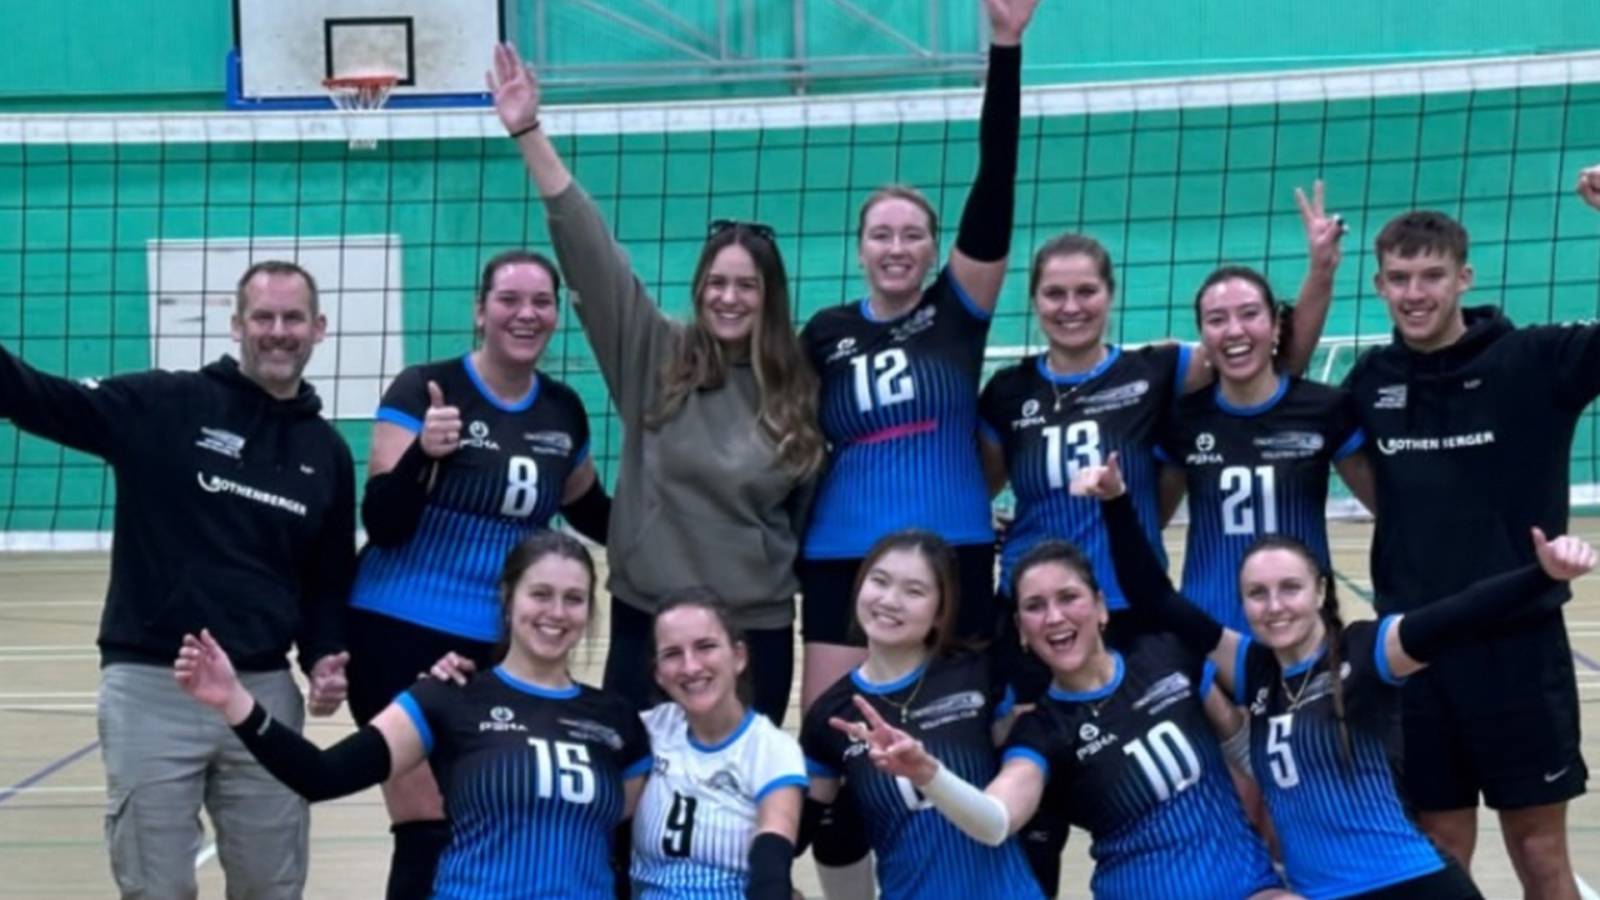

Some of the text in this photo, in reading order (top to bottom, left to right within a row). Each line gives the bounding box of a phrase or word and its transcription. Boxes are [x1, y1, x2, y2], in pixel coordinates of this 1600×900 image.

[849, 348, 915, 413] 12
[501, 455, 538, 518] 8
[1041, 419, 1102, 489] 13
[1219, 464, 1277, 536] 21
[526, 735, 596, 805] 15
[1121, 719, 1201, 802] 10
[1266, 712, 1300, 788] 5
[661, 789, 698, 859] 9
